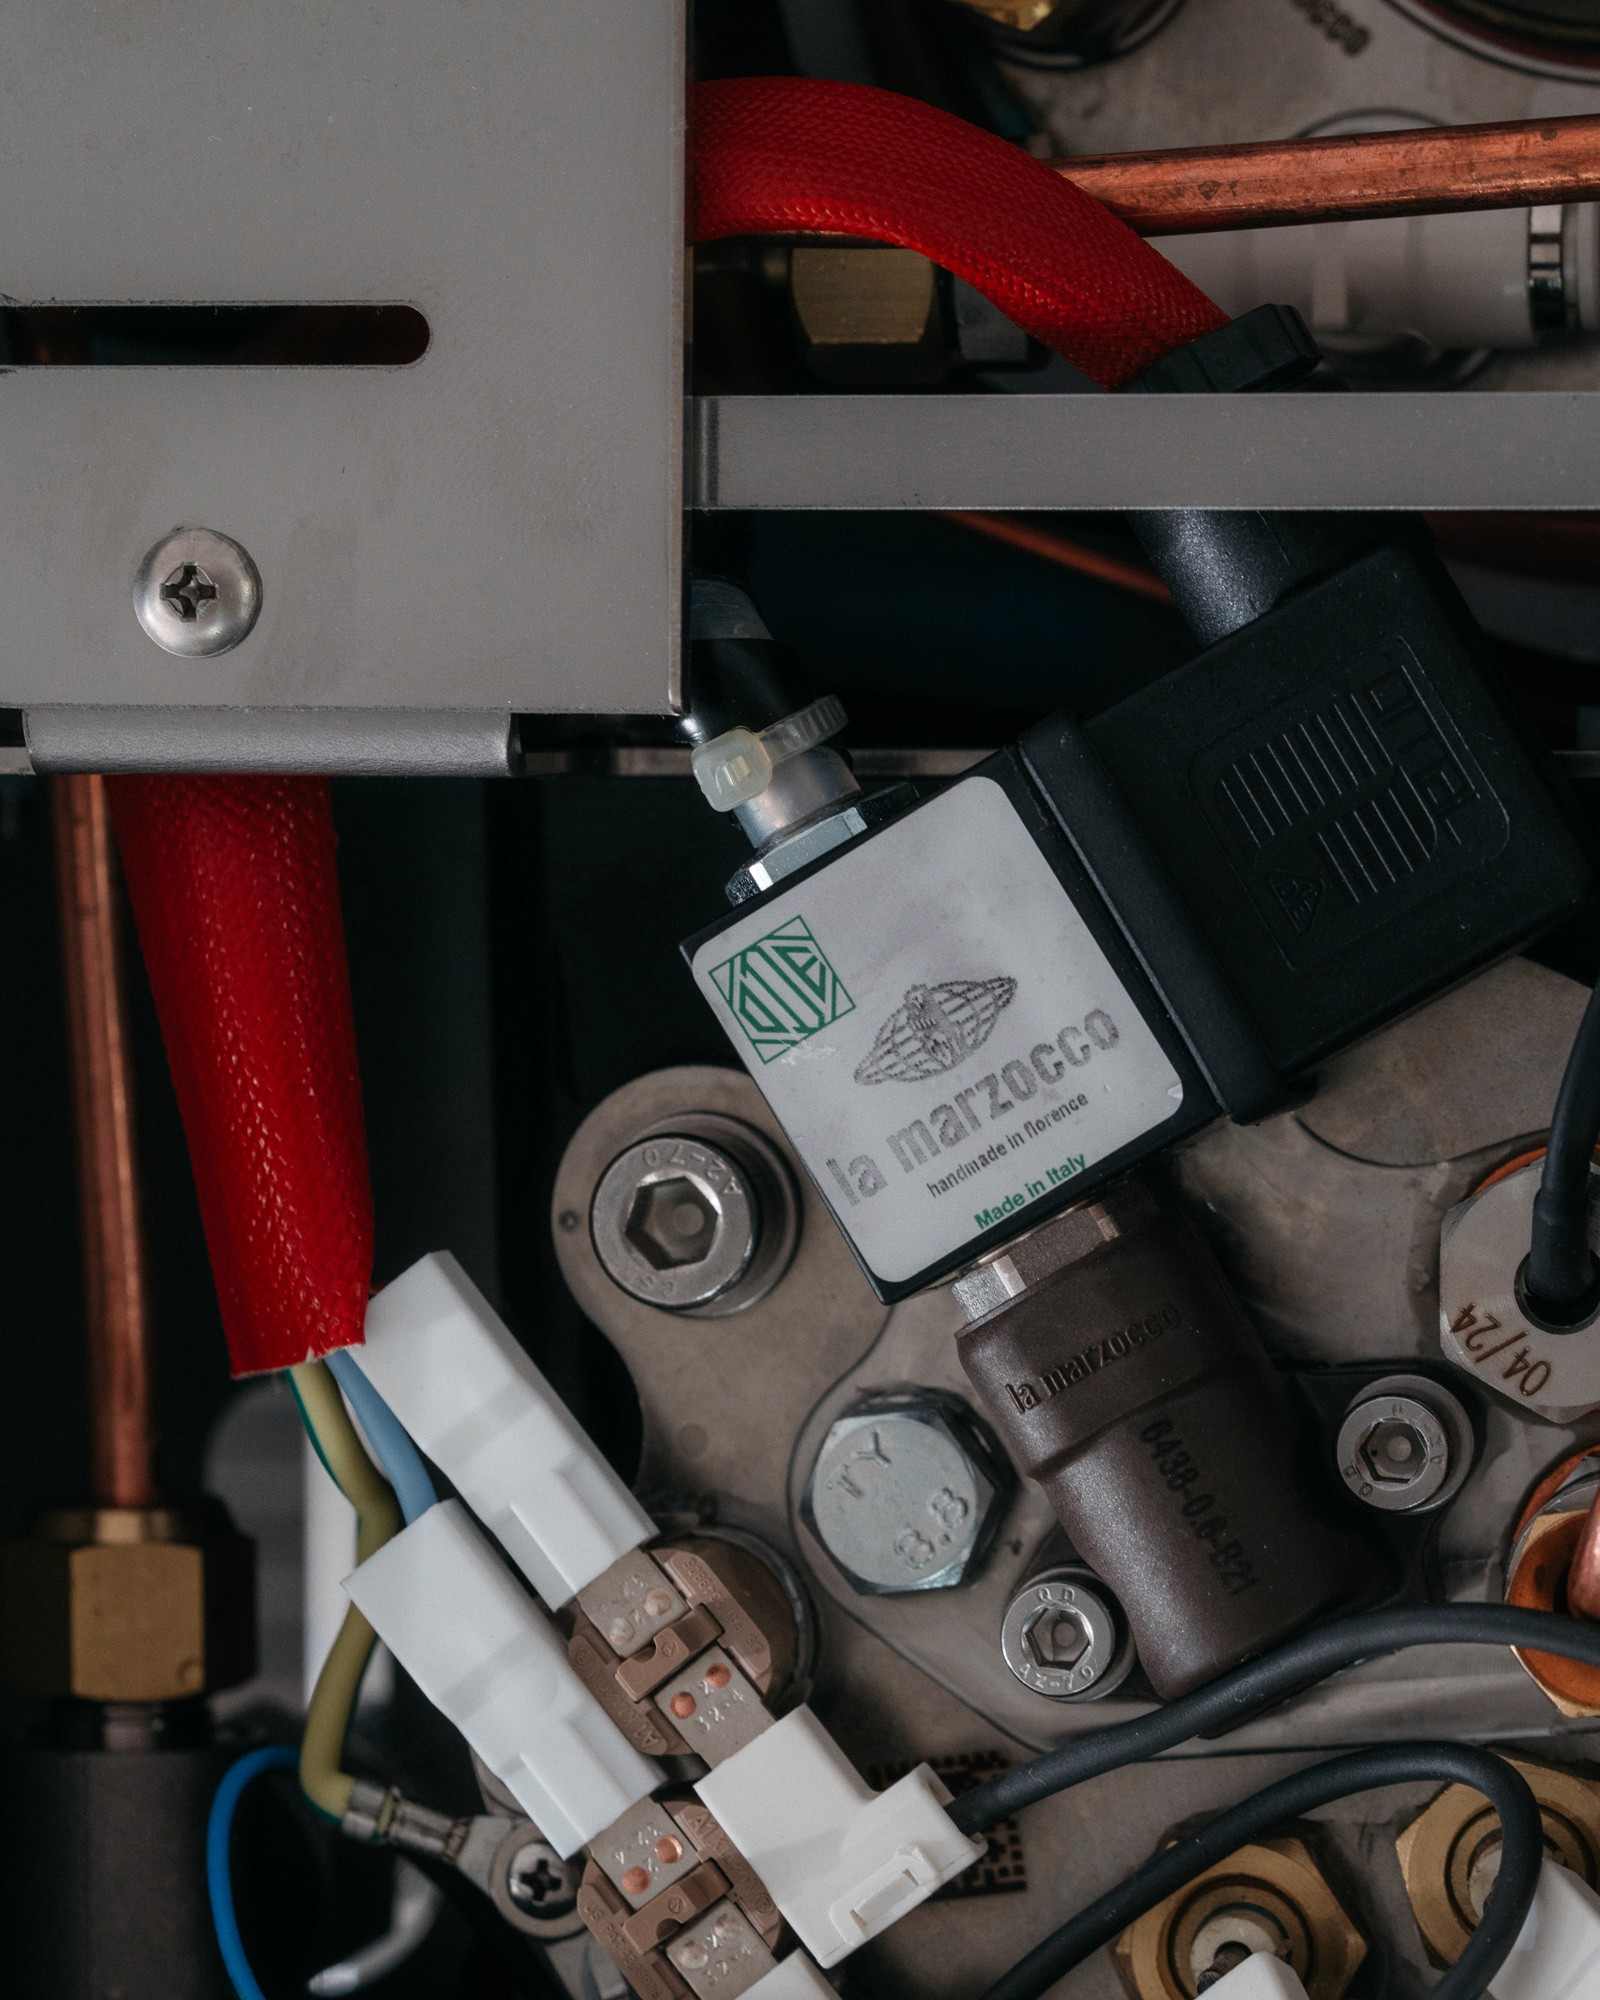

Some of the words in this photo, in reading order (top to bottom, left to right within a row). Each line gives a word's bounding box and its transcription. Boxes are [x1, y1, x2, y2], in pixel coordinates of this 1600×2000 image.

[826, 1154, 889, 1208] la
[884, 1007, 1122, 1173] marzocco
[926, 1137, 1009, 1198] handmade
[1006, 1130, 1025, 1155] in
[1023, 1091, 1089, 1144] florence
[974, 1188, 1028, 1230] Made
[1025, 1179, 1046, 1205] in
[1045, 1152, 1088, 1193] Italy
[1007, 1382, 1040, 1415] la
[1039, 1303, 1182, 1398] marzocco
[1451, 1302, 1552, 1397] 04/24
